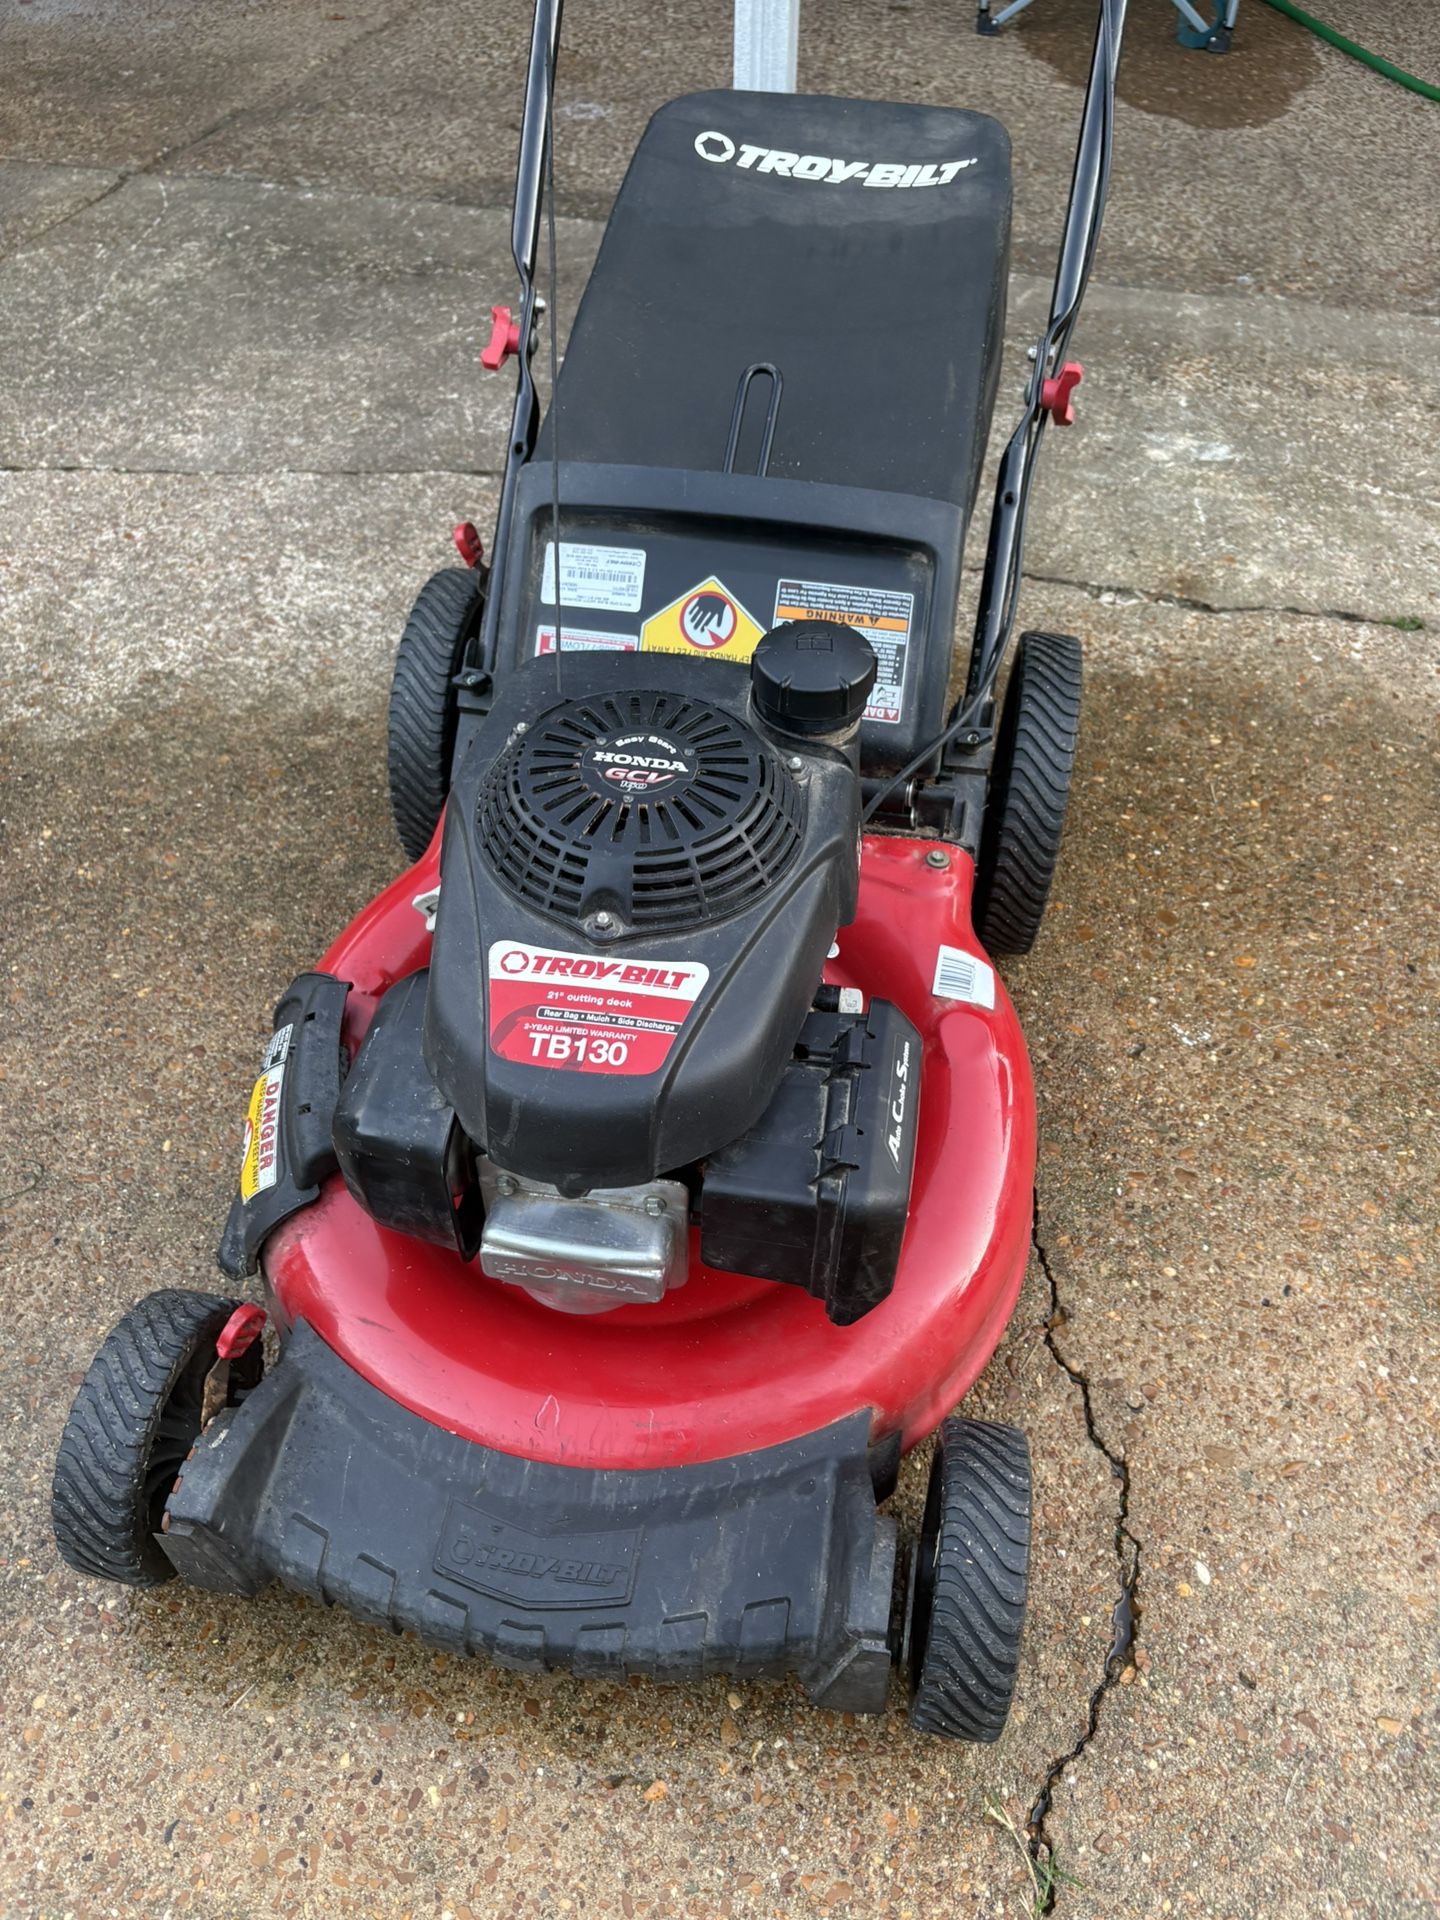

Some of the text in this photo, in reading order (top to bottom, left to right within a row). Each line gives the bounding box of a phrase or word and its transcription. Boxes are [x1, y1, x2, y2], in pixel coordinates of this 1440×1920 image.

[736, 143, 971, 188] TROY-BILT
[806, 610, 865, 623] WARNING
[592, 751, 689, 773] HONDA
[605, 767, 675, 784] GCV
[531, 955, 691, 990] TROY-BILT
[567, 992, 604, 1006] cutting
[607, 996, 633, 1008] deck
[523, 1023, 637, 1042] 2-YEAR LIMITED WARRANTY
[543, 1009, 675, 1032] Rear Bag Mulch Side Discharge
[528, 1032, 628, 1067] TB130
[892, 1084, 906, 1123] Choke
[259, 1081, 280, 1171] DANGER
[888, 1125, 902, 1162] Auto
